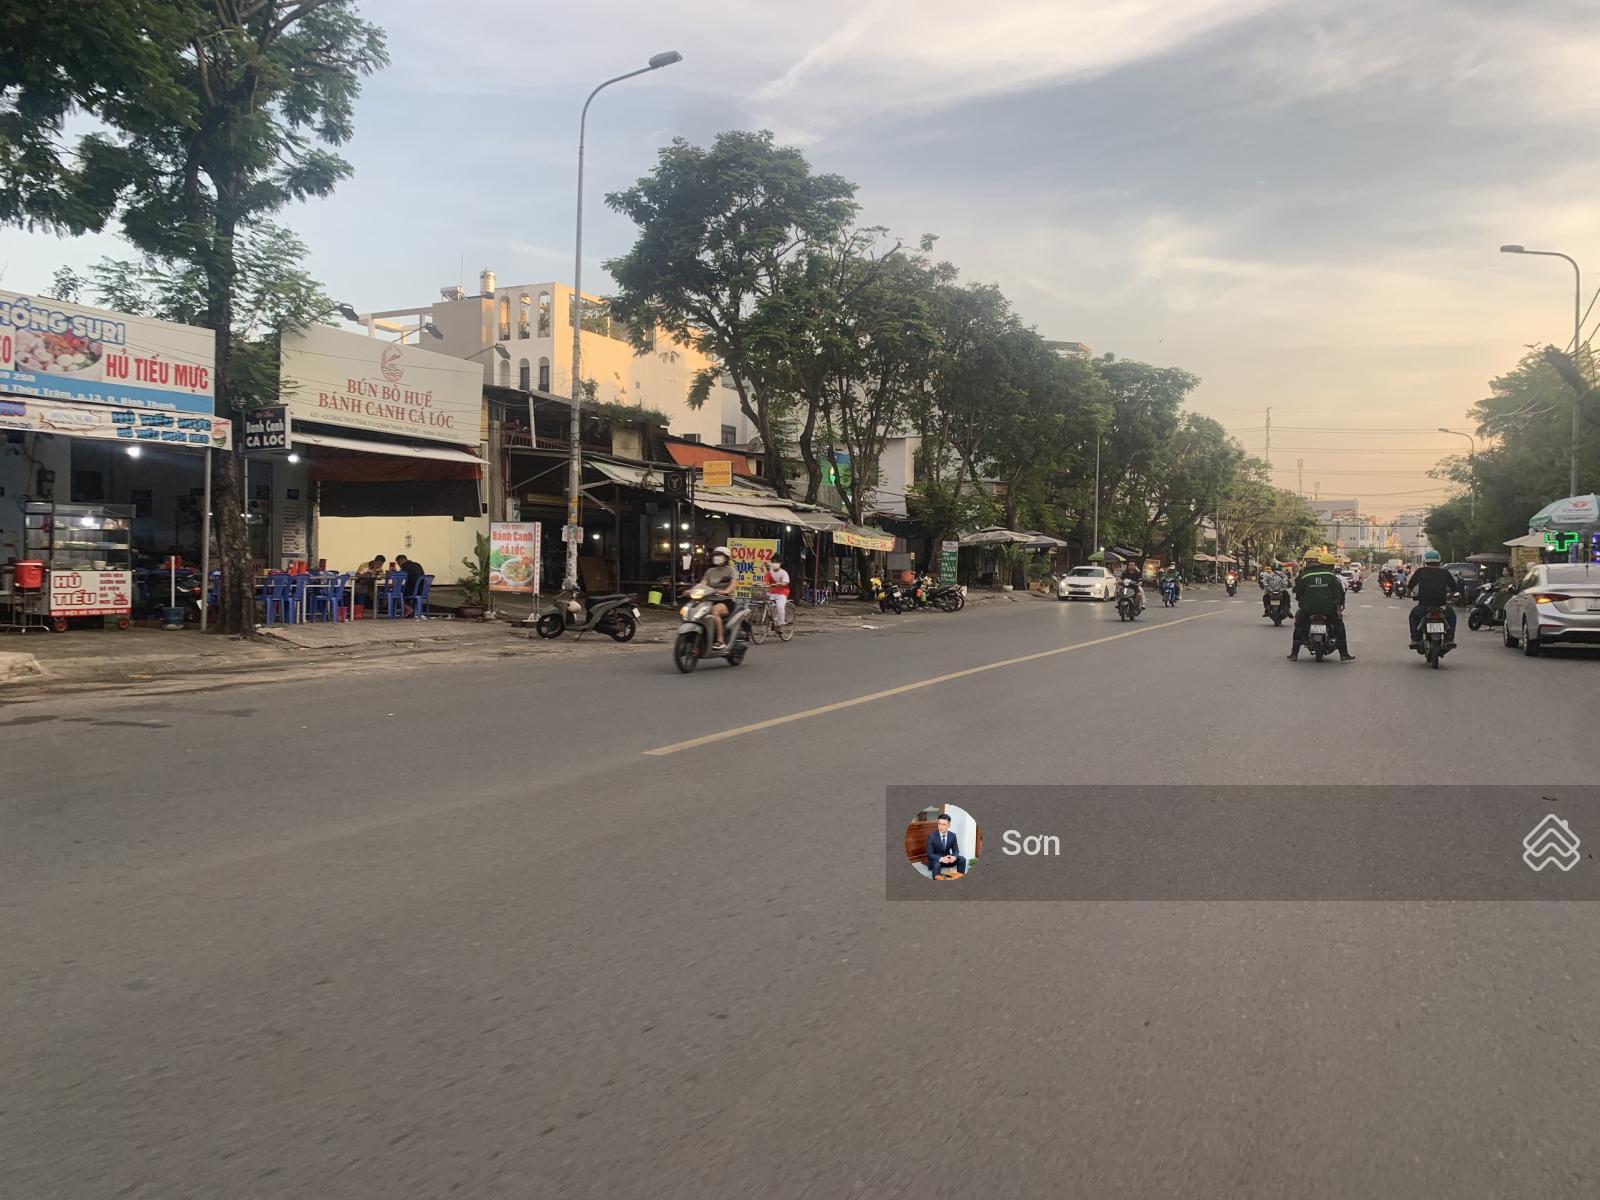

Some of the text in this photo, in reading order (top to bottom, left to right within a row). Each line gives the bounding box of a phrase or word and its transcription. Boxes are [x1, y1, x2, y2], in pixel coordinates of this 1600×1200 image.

[72, 315, 125, 345] SURI
[106, 348, 208, 392] HỦ TIẾU MỰC
[347, 378, 433, 408] BÚN BÒ HUẾ
[319, 391, 361, 413] BÁNH
[365, 401, 405, 421] CANH
[409, 407, 426, 424] CÁ
[430, 411, 454, 429] LÓC
[730, 545, 773, 561] CƠM 42
[54, 572, 81, 588] HỦ
[53, 589, 96, 606] TIẾU
